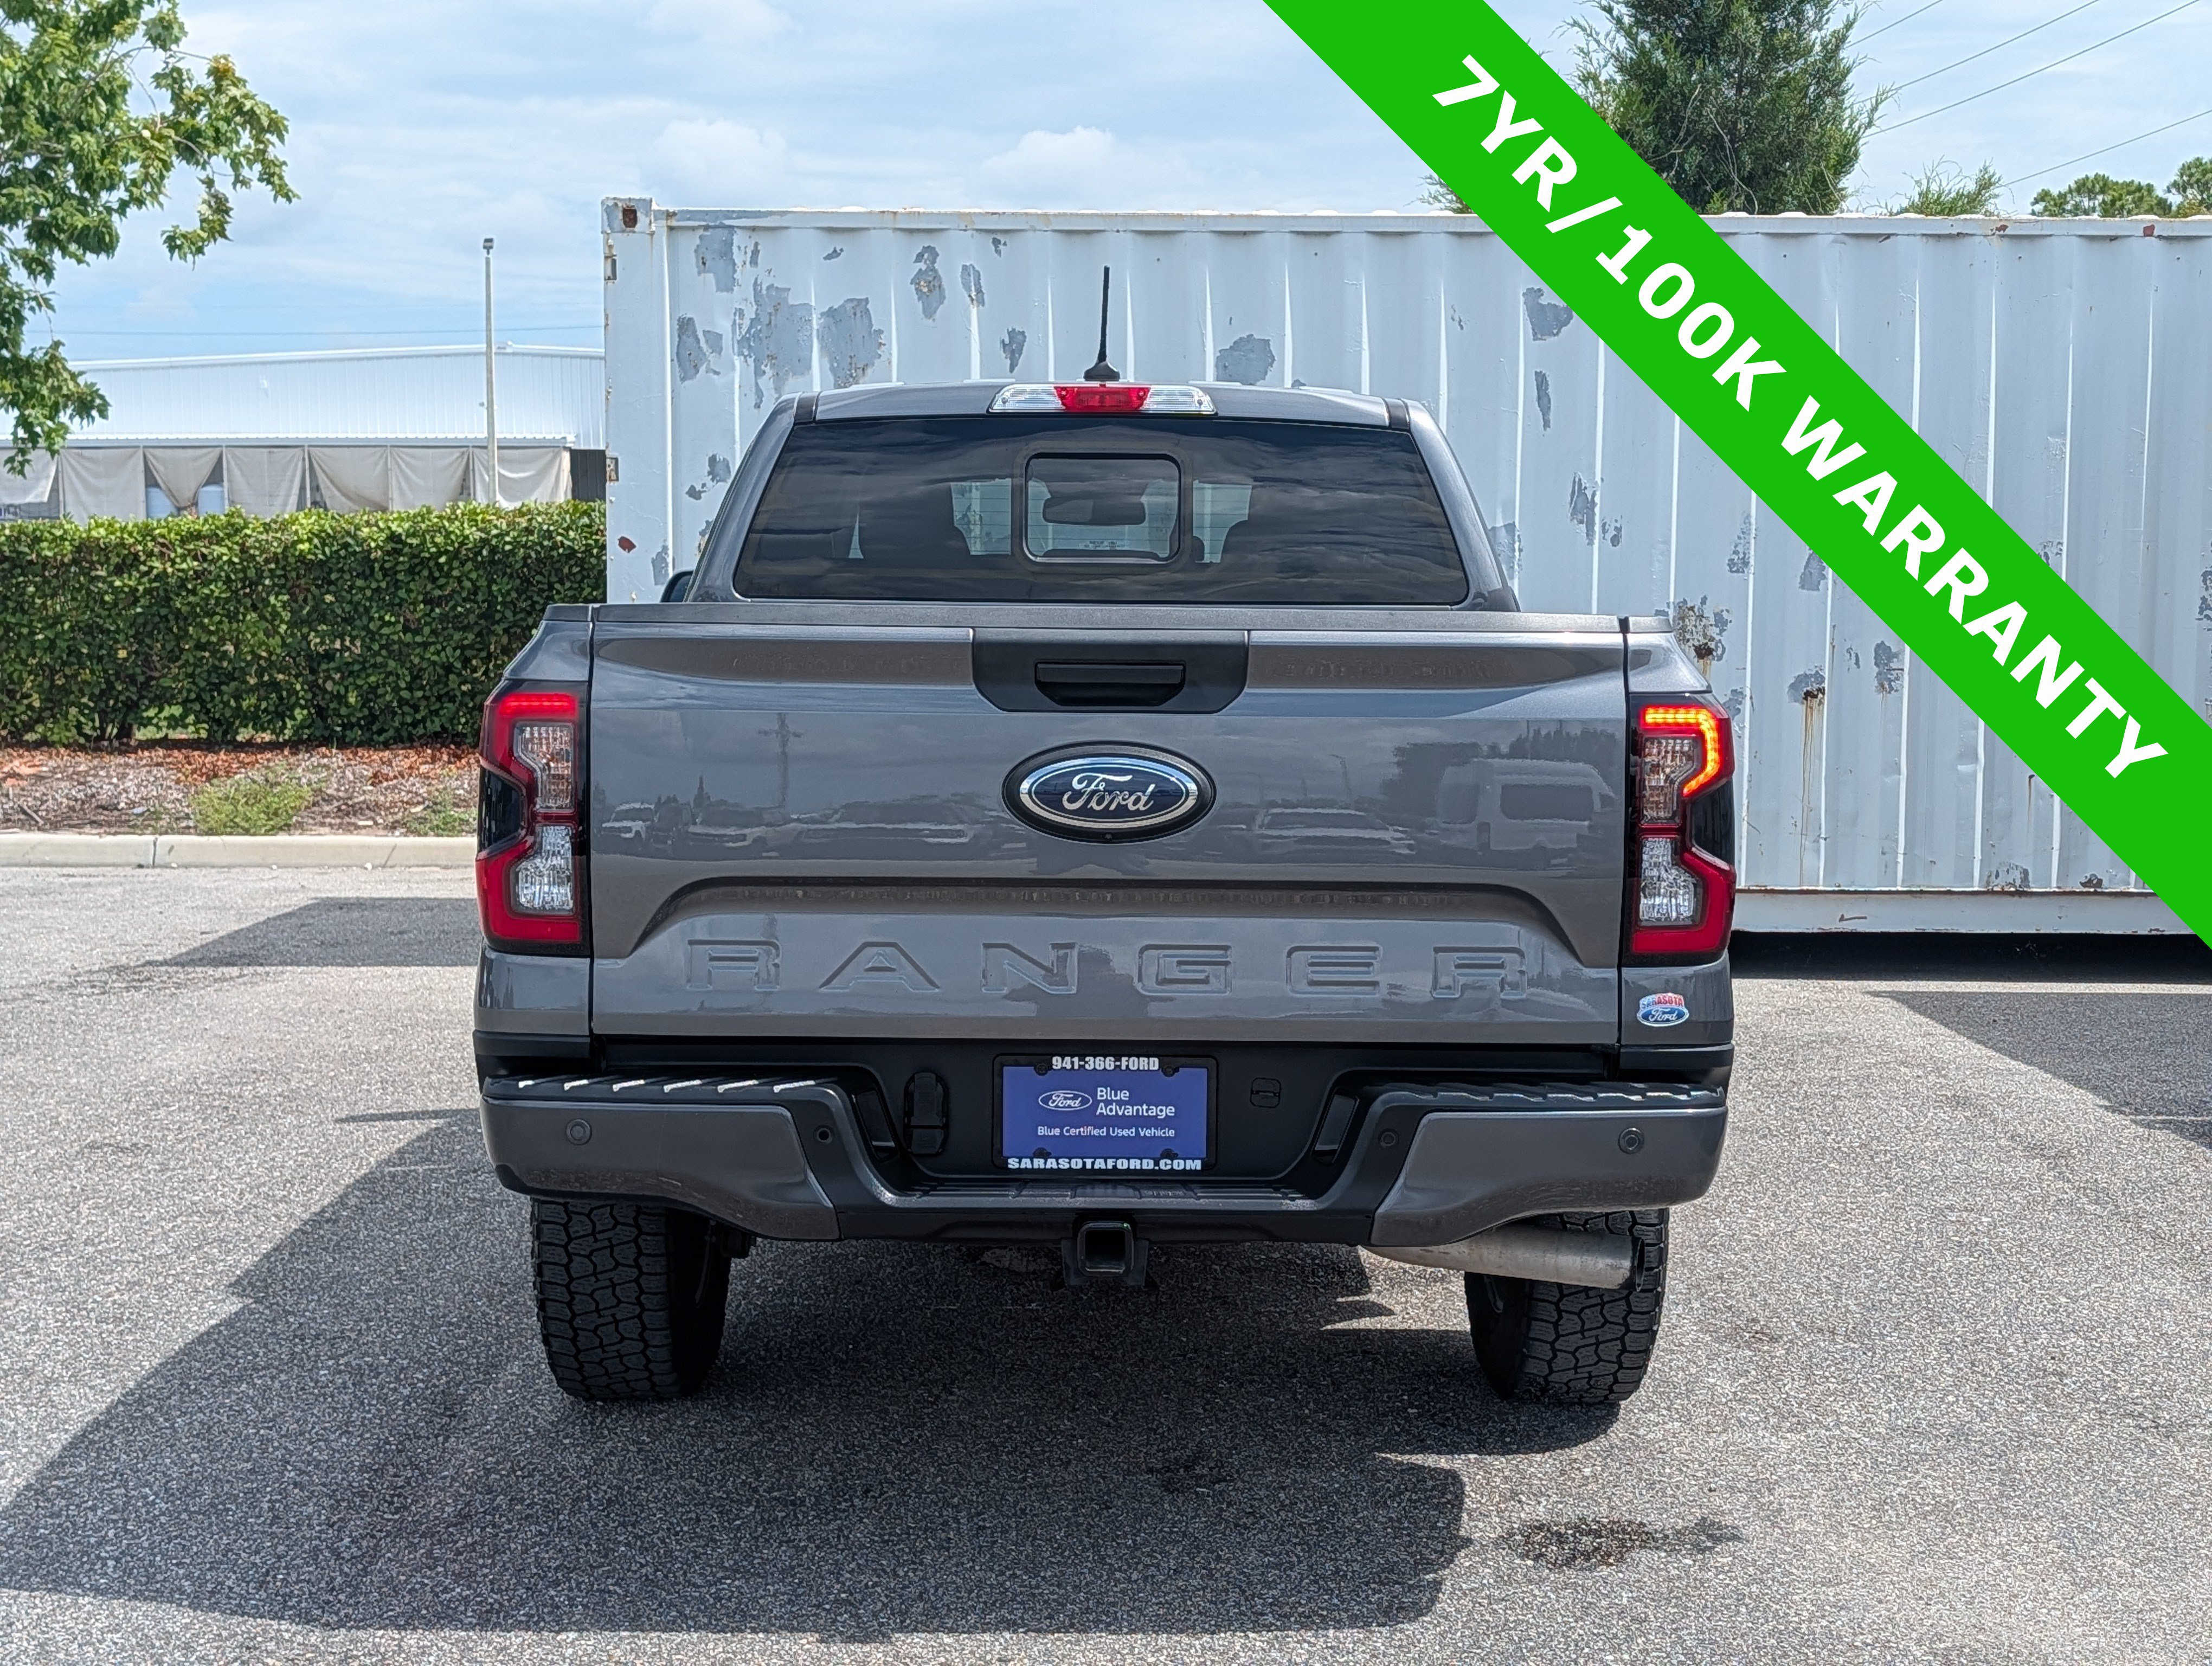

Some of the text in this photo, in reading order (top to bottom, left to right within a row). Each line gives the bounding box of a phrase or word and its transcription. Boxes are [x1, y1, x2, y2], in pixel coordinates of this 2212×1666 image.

[1062, 772, 1156, 811] Ford
[686, 939, 1527, 998] RANGER
[1648, 1008, 1678, 1021] Ford
[1052, 1056, 1159, 1071] 941-366-FORD
[1048, 1093, 1082, 1107] Ford
[1097, 1087, 1129, 1100] Blue
[1096, 1103, 1175, 1119] Advantage
[1038, 1126, 1175, 1137] Blue Certified Used Vehicle
[1007, 1157, 1202, 1170] SARASOTAFORD.COM
